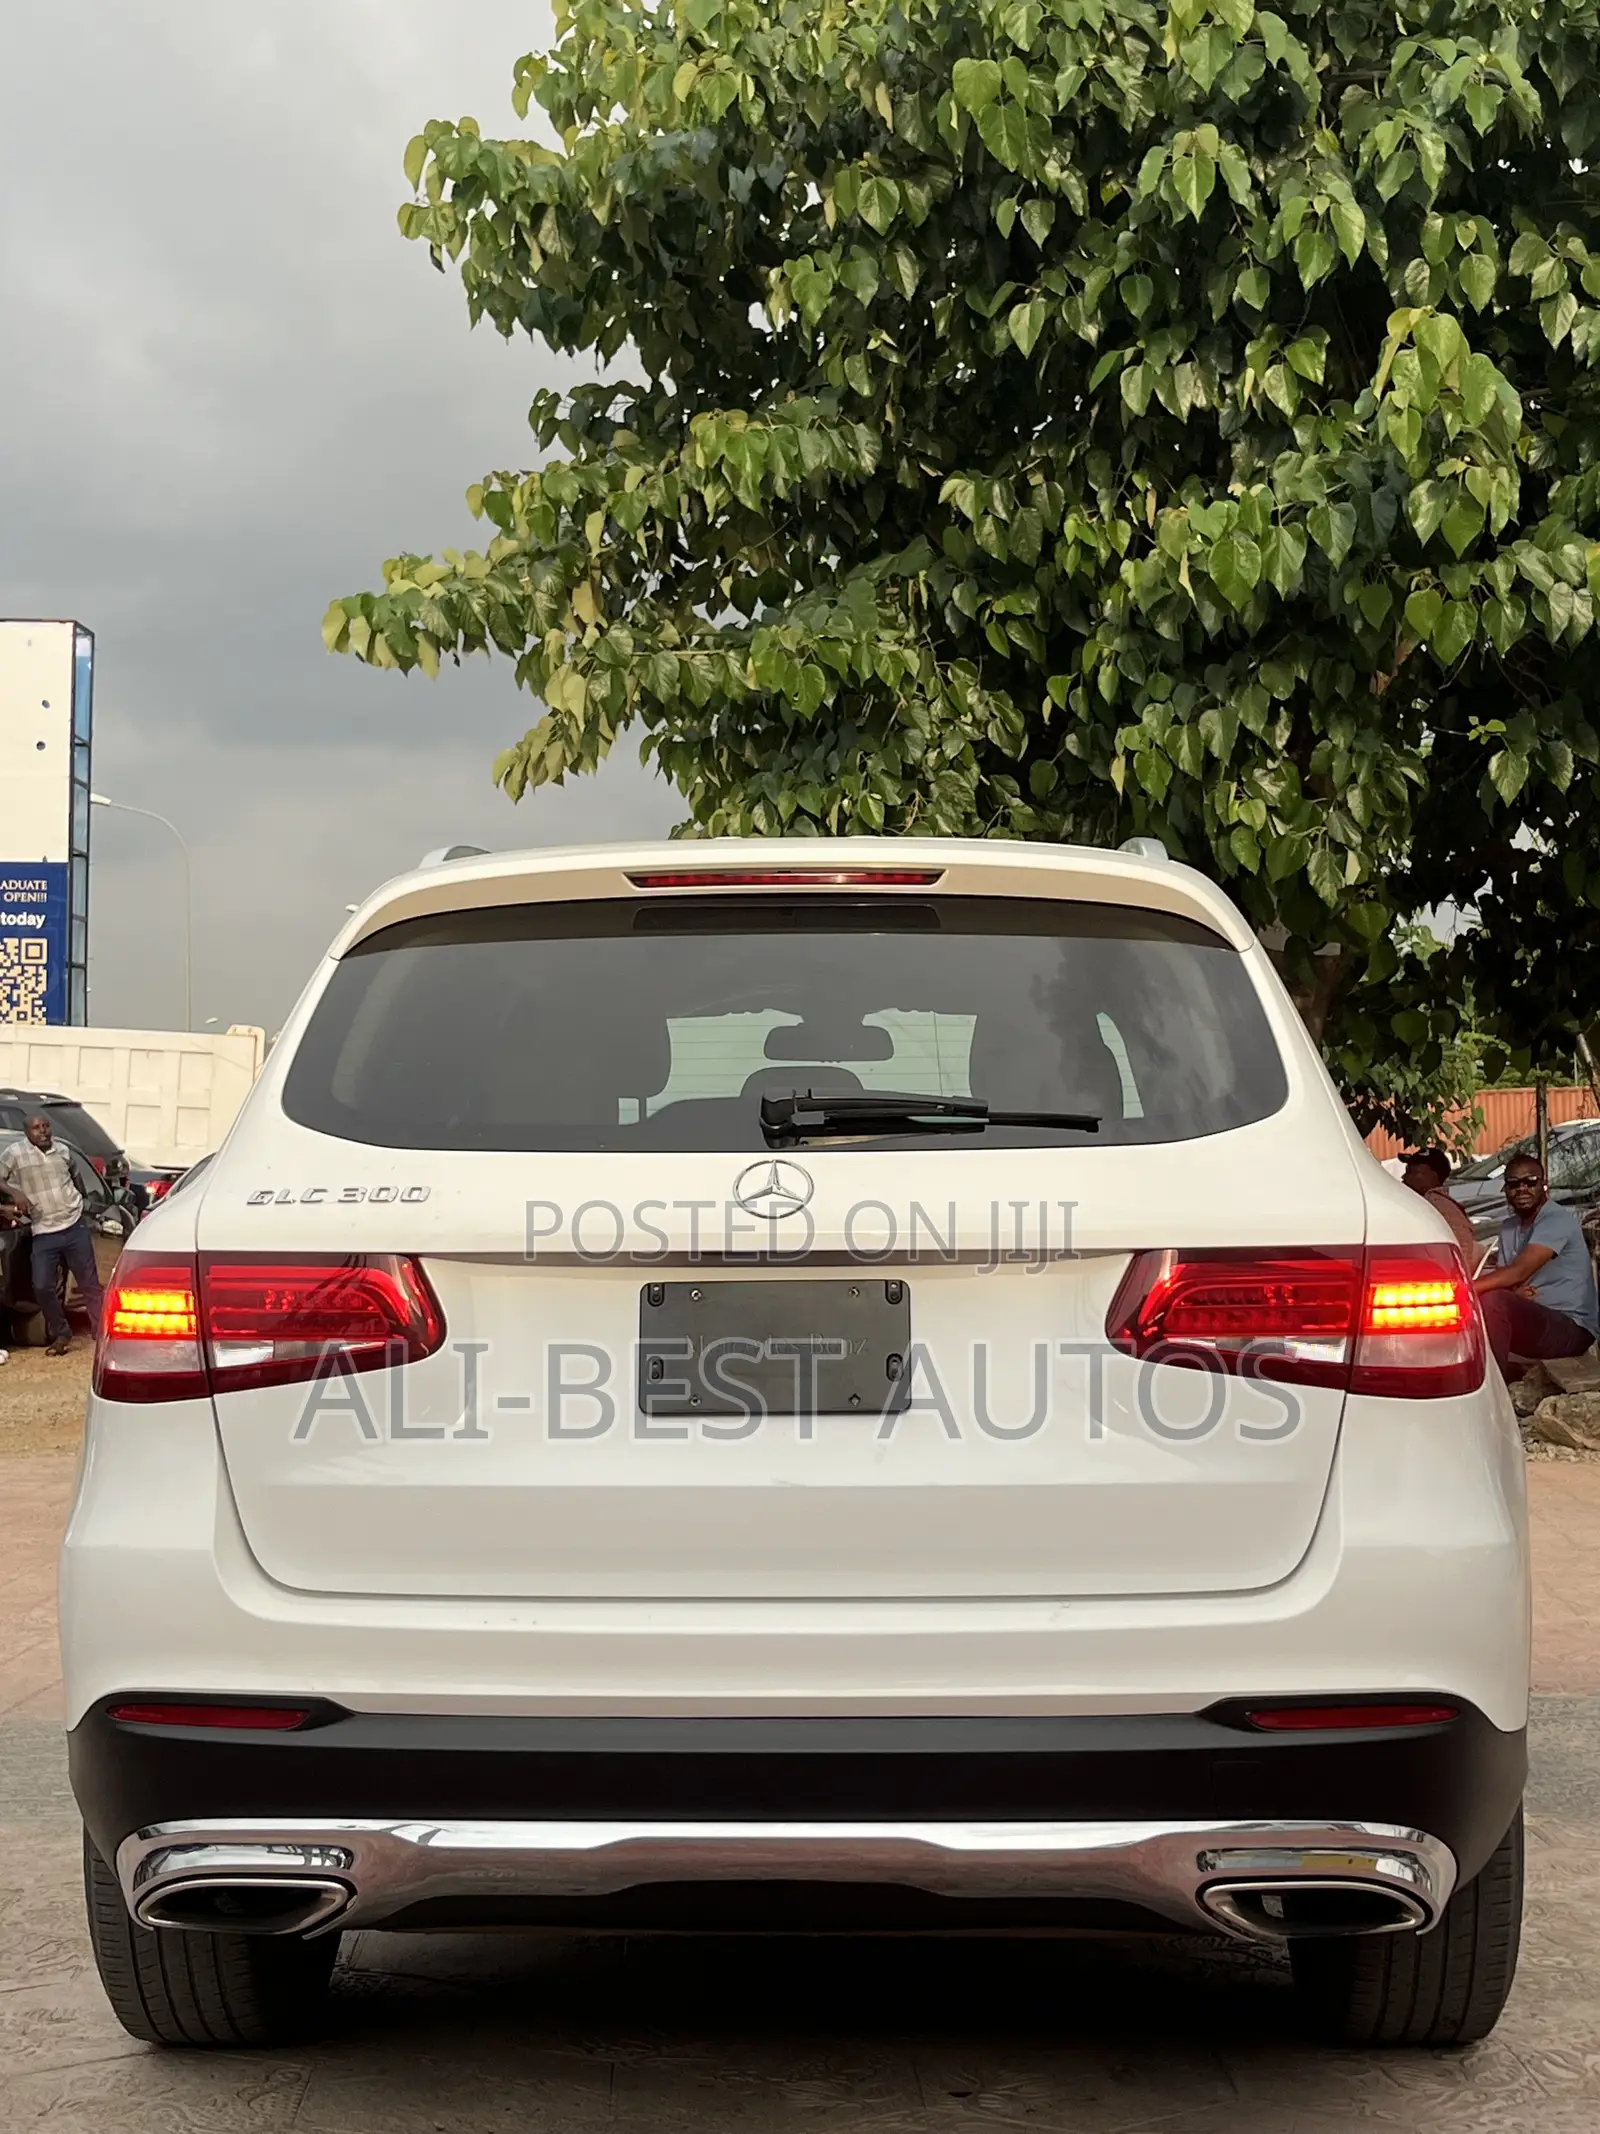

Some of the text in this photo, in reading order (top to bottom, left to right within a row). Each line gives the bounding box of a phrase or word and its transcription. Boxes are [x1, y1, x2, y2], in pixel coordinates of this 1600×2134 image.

[0, 911, 46, 929] today
[247, 1186, 431, 1204] GLC 300
